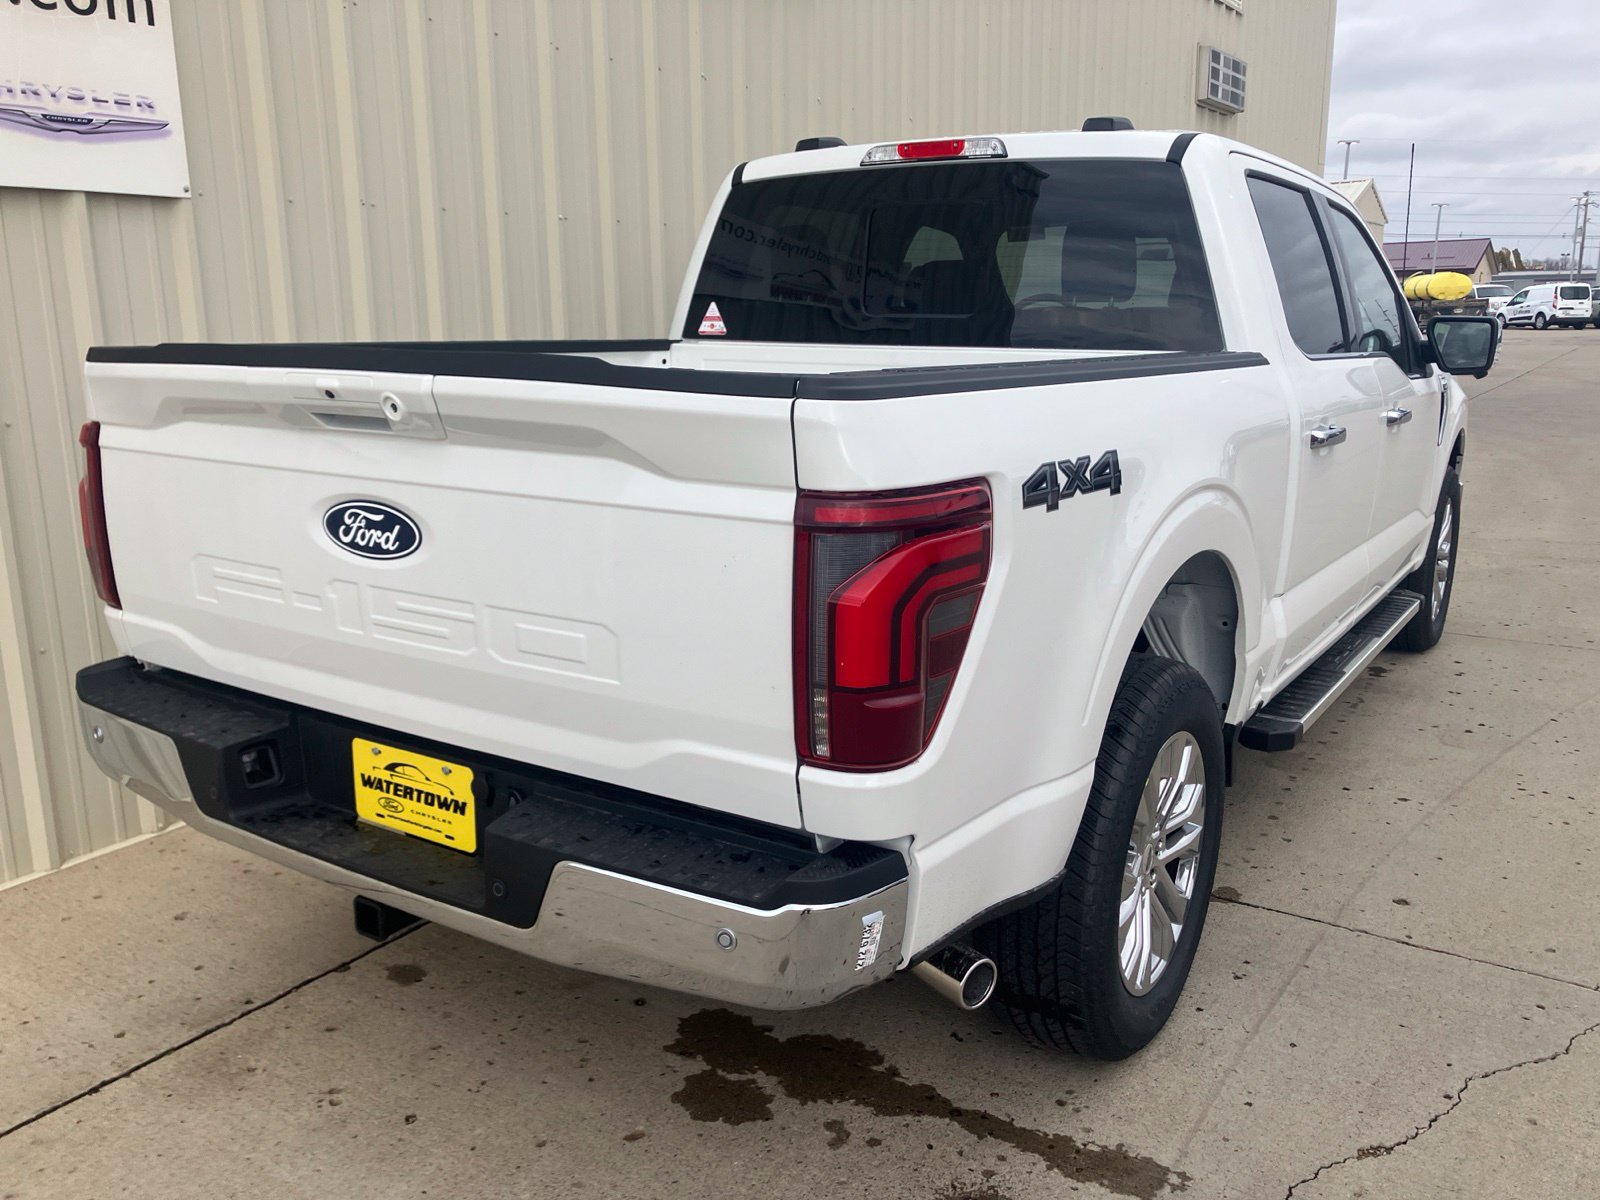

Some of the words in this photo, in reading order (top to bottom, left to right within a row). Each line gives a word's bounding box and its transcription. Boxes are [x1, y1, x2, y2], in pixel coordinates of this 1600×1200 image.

[9, 0, 155, 26] .om
[338, 507, 401, 552] Ford
[192, 553, 621, 685] F-150
[360, 772, 467, 817] WATERTOWN
[410, 809, 453, 825] CHRYSLER
